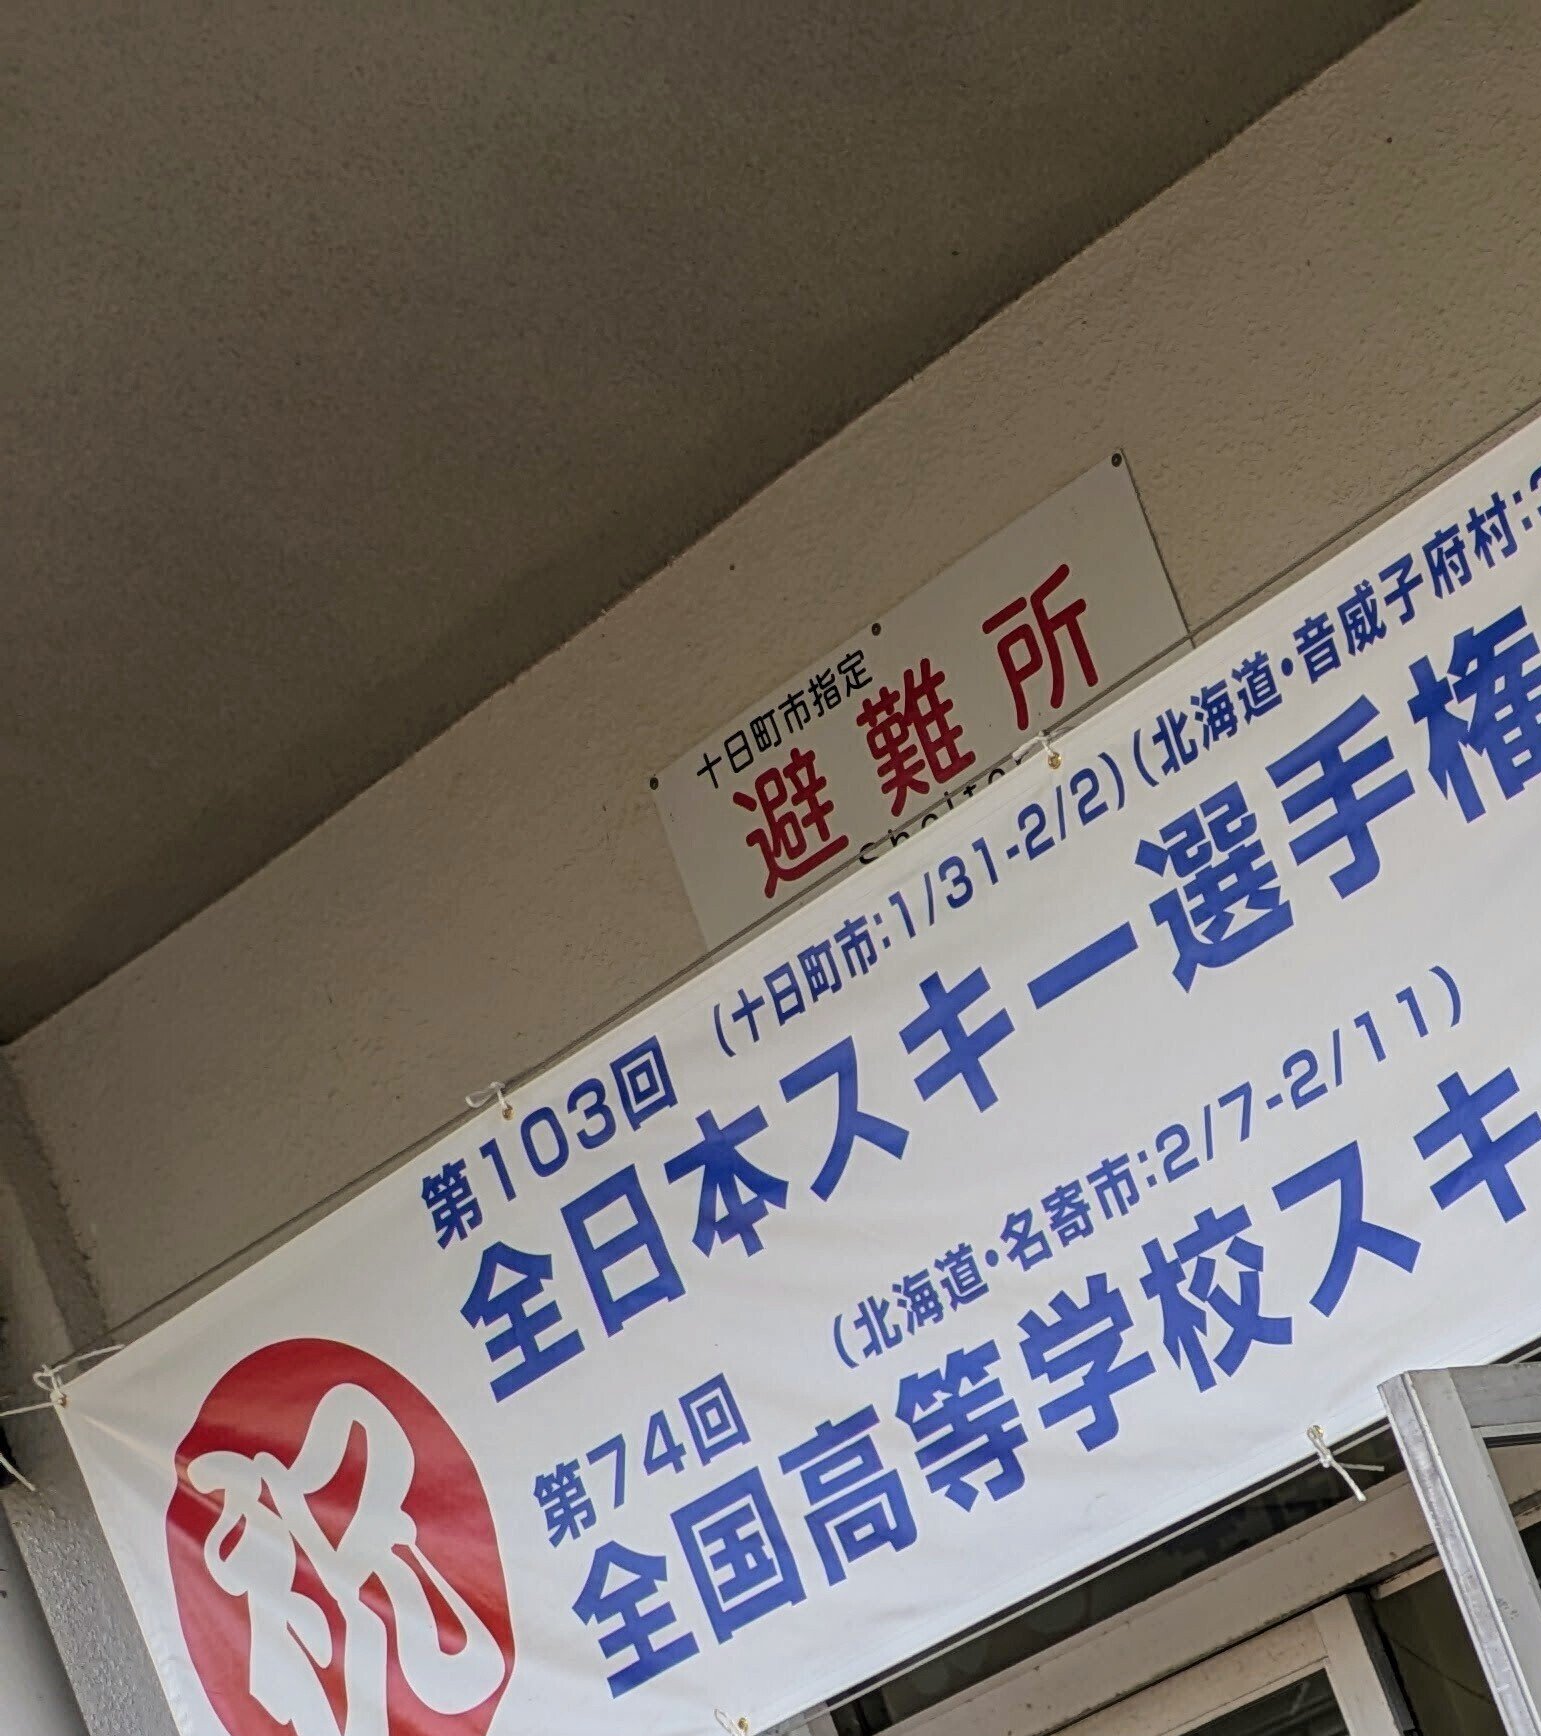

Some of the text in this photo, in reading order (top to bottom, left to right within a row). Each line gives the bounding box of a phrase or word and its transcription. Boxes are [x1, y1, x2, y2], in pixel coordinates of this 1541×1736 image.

[696, 649, 873, 790] 十日町市指定
[732, 562, 1100, 898] 避難所
[420, 1034, 679, 1251] 第103回
[533, 1372, 754, 1548] 第74回
